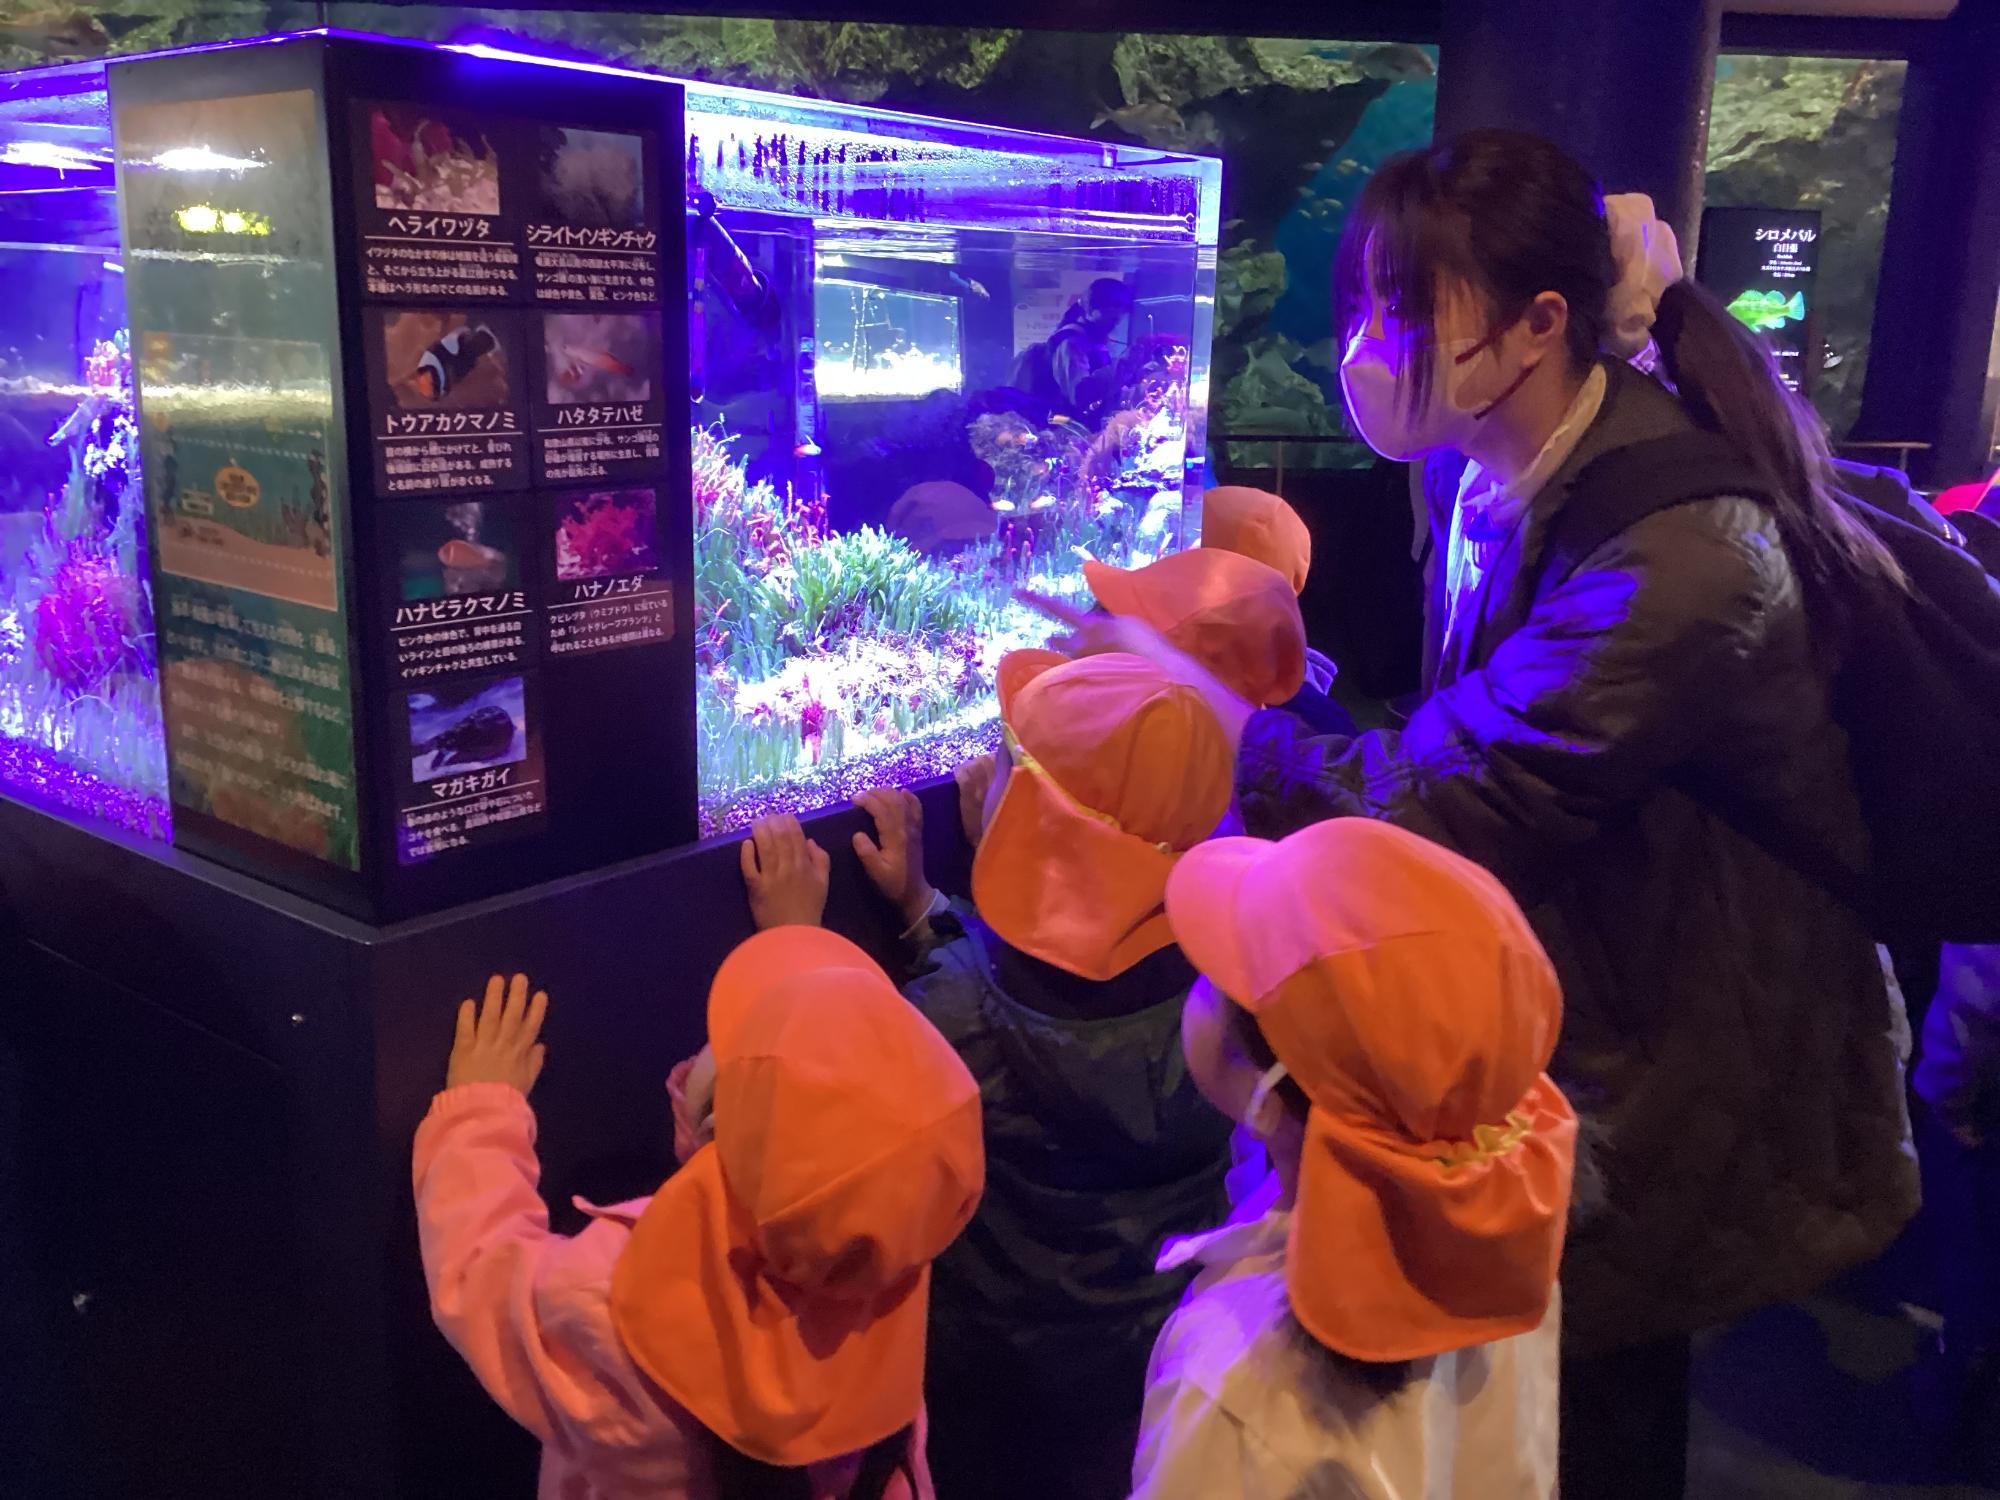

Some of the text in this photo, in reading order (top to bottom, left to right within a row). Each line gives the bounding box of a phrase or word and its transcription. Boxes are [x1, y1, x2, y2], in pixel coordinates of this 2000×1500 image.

[388, 215, 490, 238] ヘライワヅタ
[526, 224, 657, 248] シライトイソギンチャク
[1754, 228, 1817, 243] シロメバル
[386, 411, 515, 434] トウアカクマノミ
[557, 404, 643, 425] ハタタテハゼ
[574, 574, 645, 599] ハナノエダ
[396, 591, 525, 624] ハナビラクマノミ
[432, 767, 510, 798] マガキガイ
